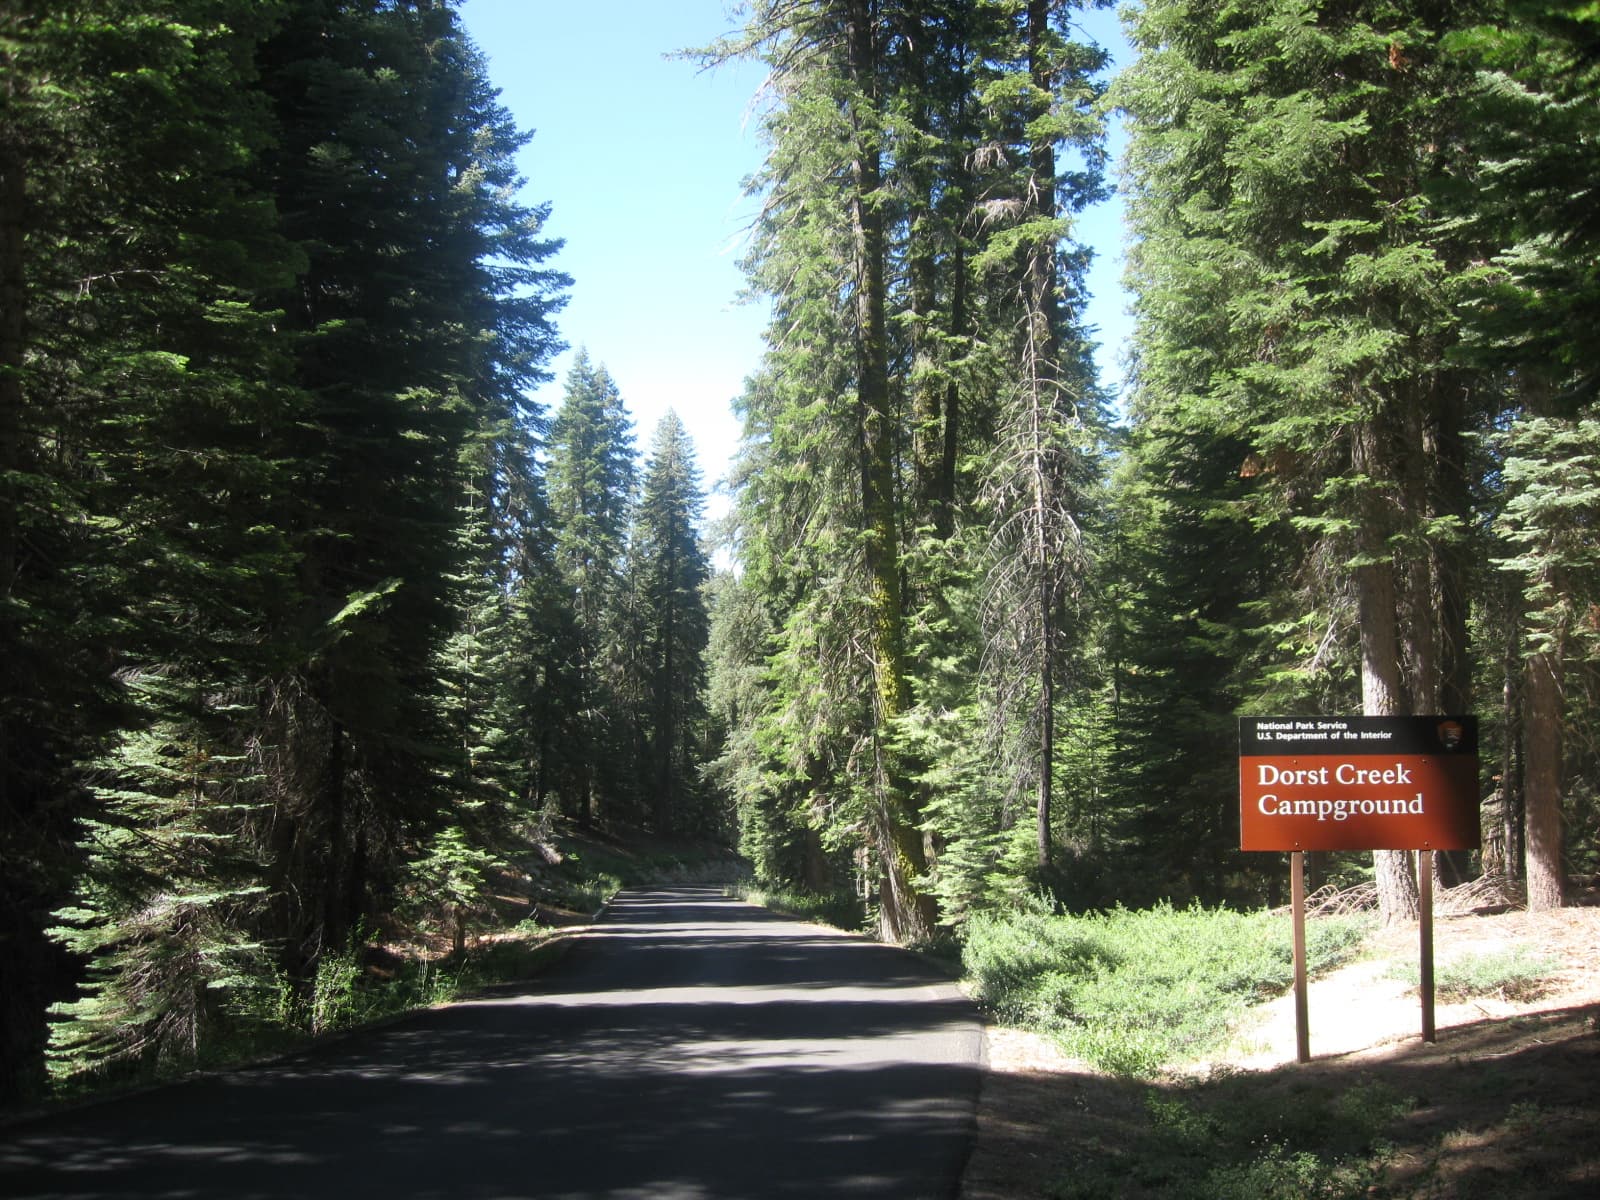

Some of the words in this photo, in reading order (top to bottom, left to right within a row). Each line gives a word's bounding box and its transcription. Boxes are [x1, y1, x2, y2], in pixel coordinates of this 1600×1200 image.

[1257, 722, 1293, 730] National
[1296, 722, 1314, 730] Park
[1318, 722, 1347, 730] Service
[1276, 732, 1328, 742] Department
[1330, 732, 1341, 740] of
[1344, 732, 1358, 740] the
[1361, 731, 1392, 740] Interior
[1258, 765, 1328, 785] Dorst
[1336, 764, 1412, 784] Creek
[1258, 793, 1424, 820] Campground
